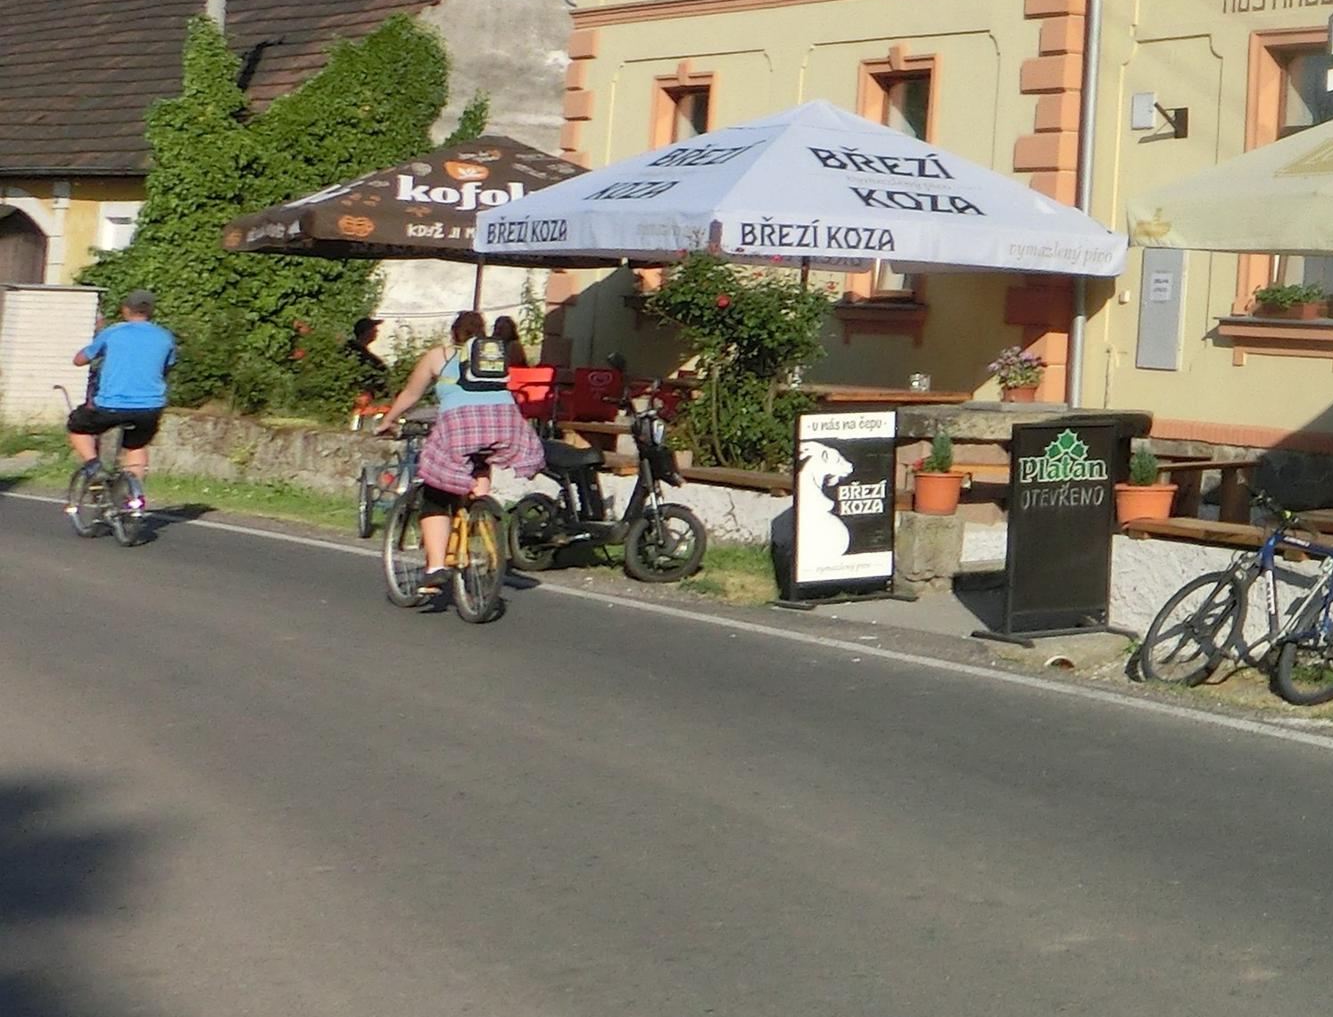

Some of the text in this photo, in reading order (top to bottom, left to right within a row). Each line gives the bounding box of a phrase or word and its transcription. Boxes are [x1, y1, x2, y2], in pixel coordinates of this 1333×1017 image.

[647, 139, 768, 168] BŘEZÍ
[806, 145, 957, 180] BŘEZÍ
[396, 174, 537, 212] kofol
[583, 180, 681, 200] KOZA
[849, 186, 988, 216] KOZA
[486, 215, 530, 245] BŘEZÍ
[531, 218, 568, 242] KOZA
[740, 216, 819, 249] BŘEZÍ
[826, 224, 896, 252] KOZA
[842, 420, 857, 430] na
[1019, 454, 1108, 483] Platan
[838, 479, 888, 501] BŘEZÍ
[1021, 483, 1105, 510] OTEVŘENO
[839, 498, 884, 516] KOZA
